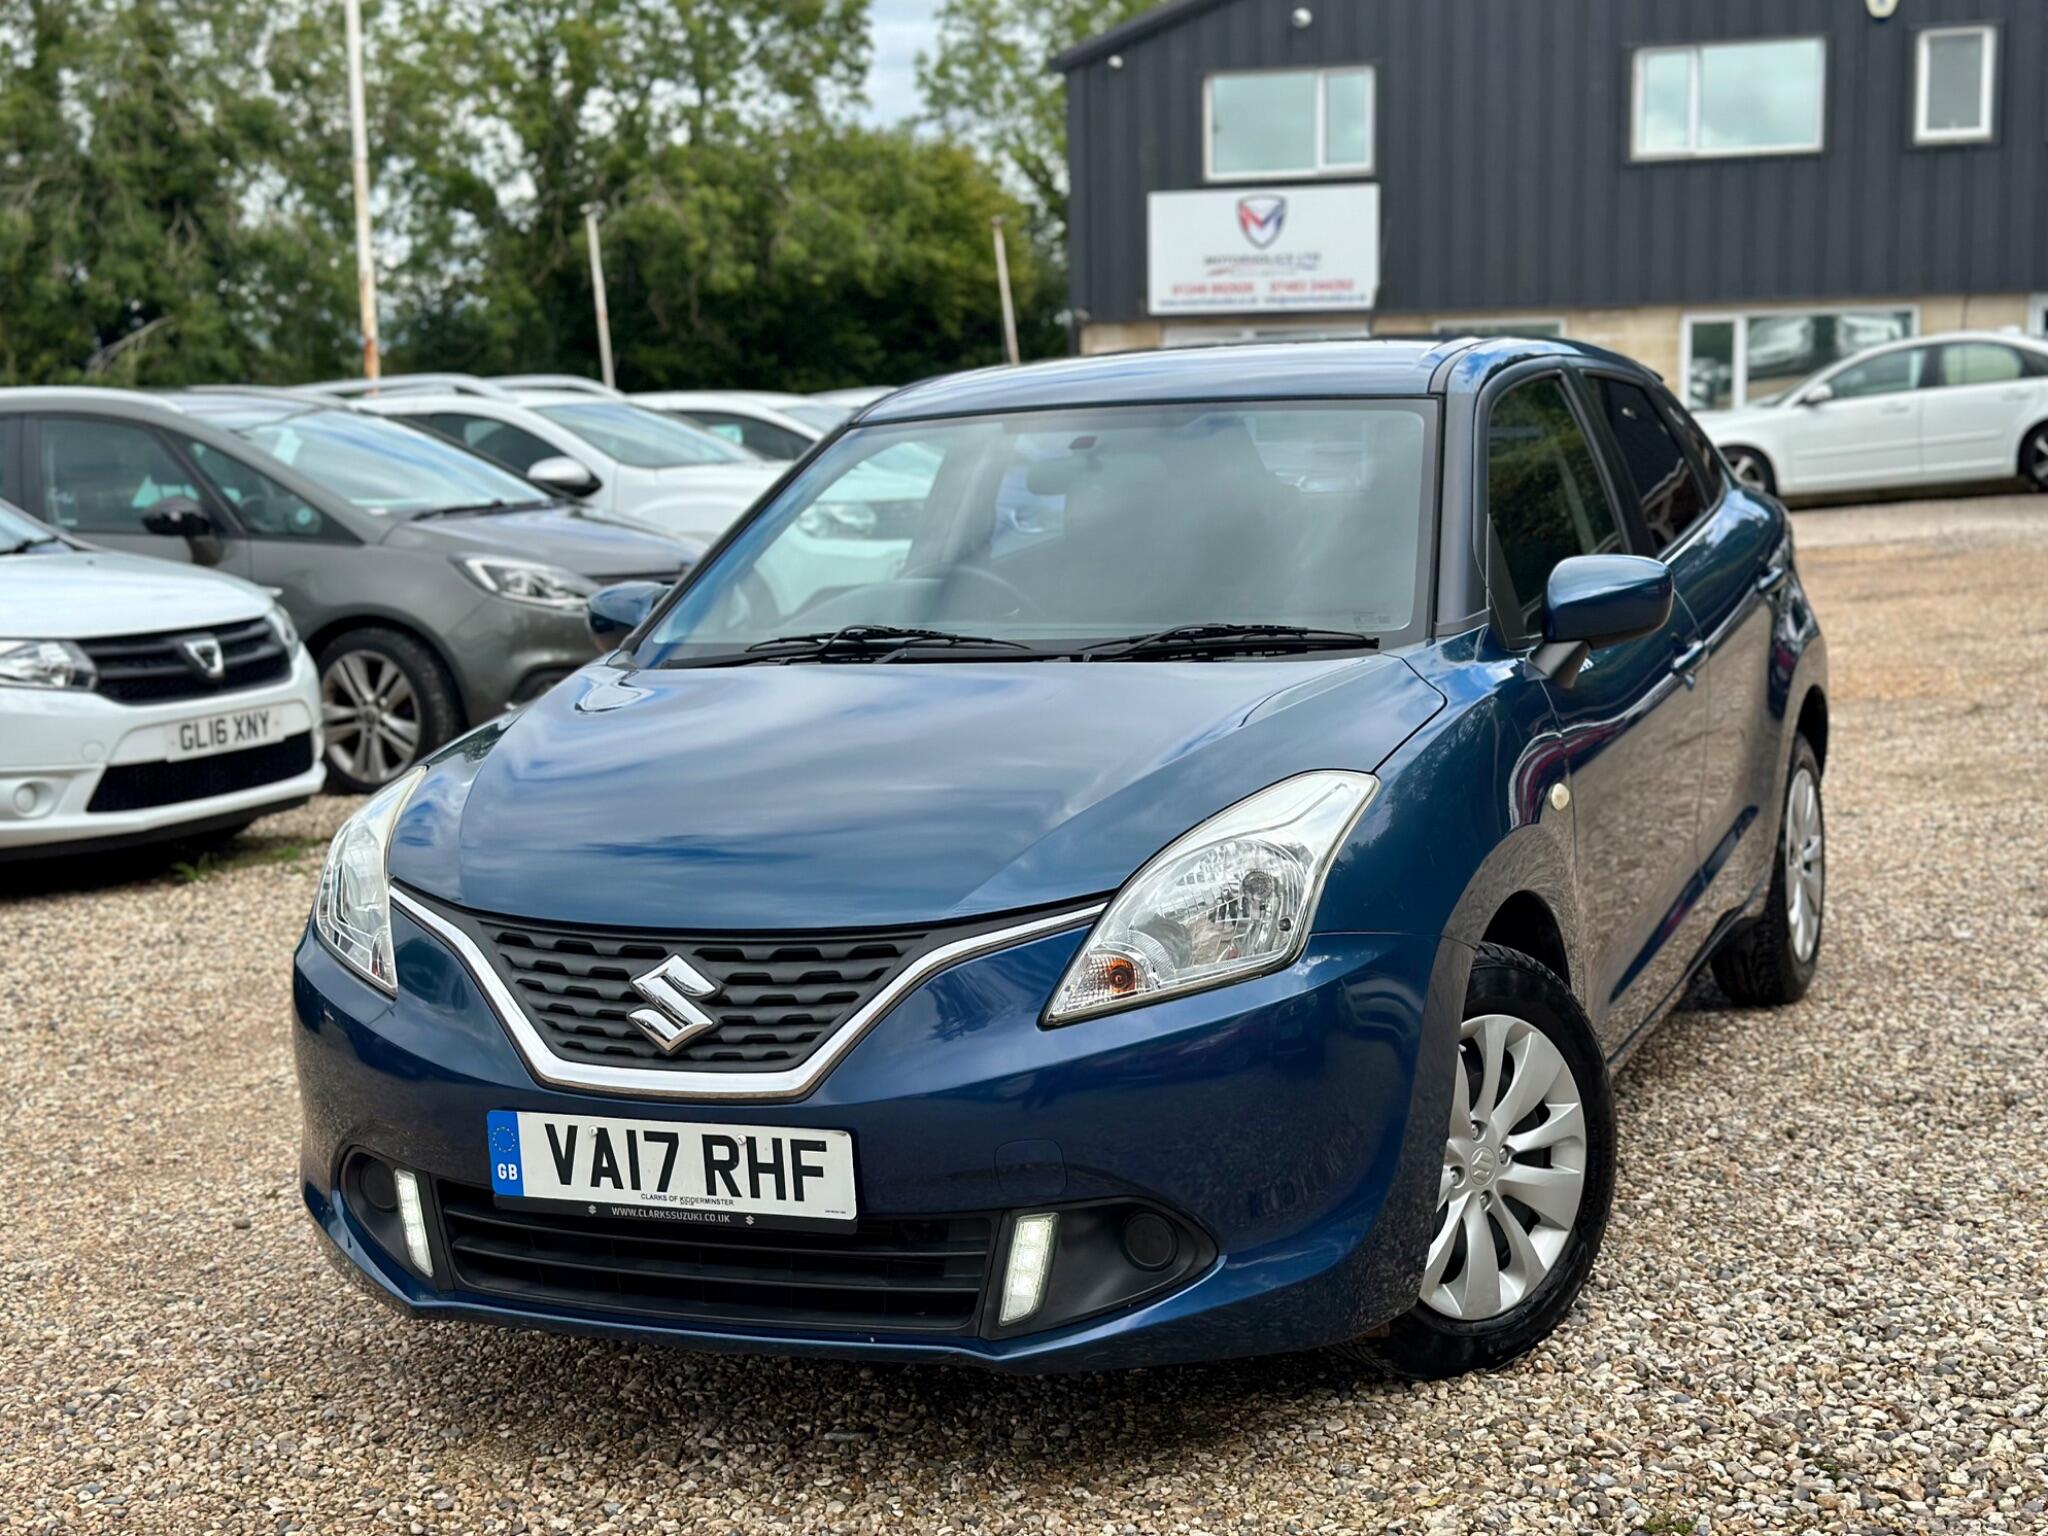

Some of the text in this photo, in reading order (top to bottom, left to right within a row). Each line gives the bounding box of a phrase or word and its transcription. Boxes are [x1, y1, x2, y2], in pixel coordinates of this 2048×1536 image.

[180, 711, 270, 751] GL16 XNY
[497, 1162, 518, 1181] GB
[544, 1122, 828, 1202] VA17 RHF
[640, 1193, 668, 1202] CLARKS
[668, 1195, 679, 1203] OF
[680, 1196, 735, 1206] KIDDERMINSTER
[611, 1205, 731, 1224] WWW.CLARKSSUZUKI.CO.UK
